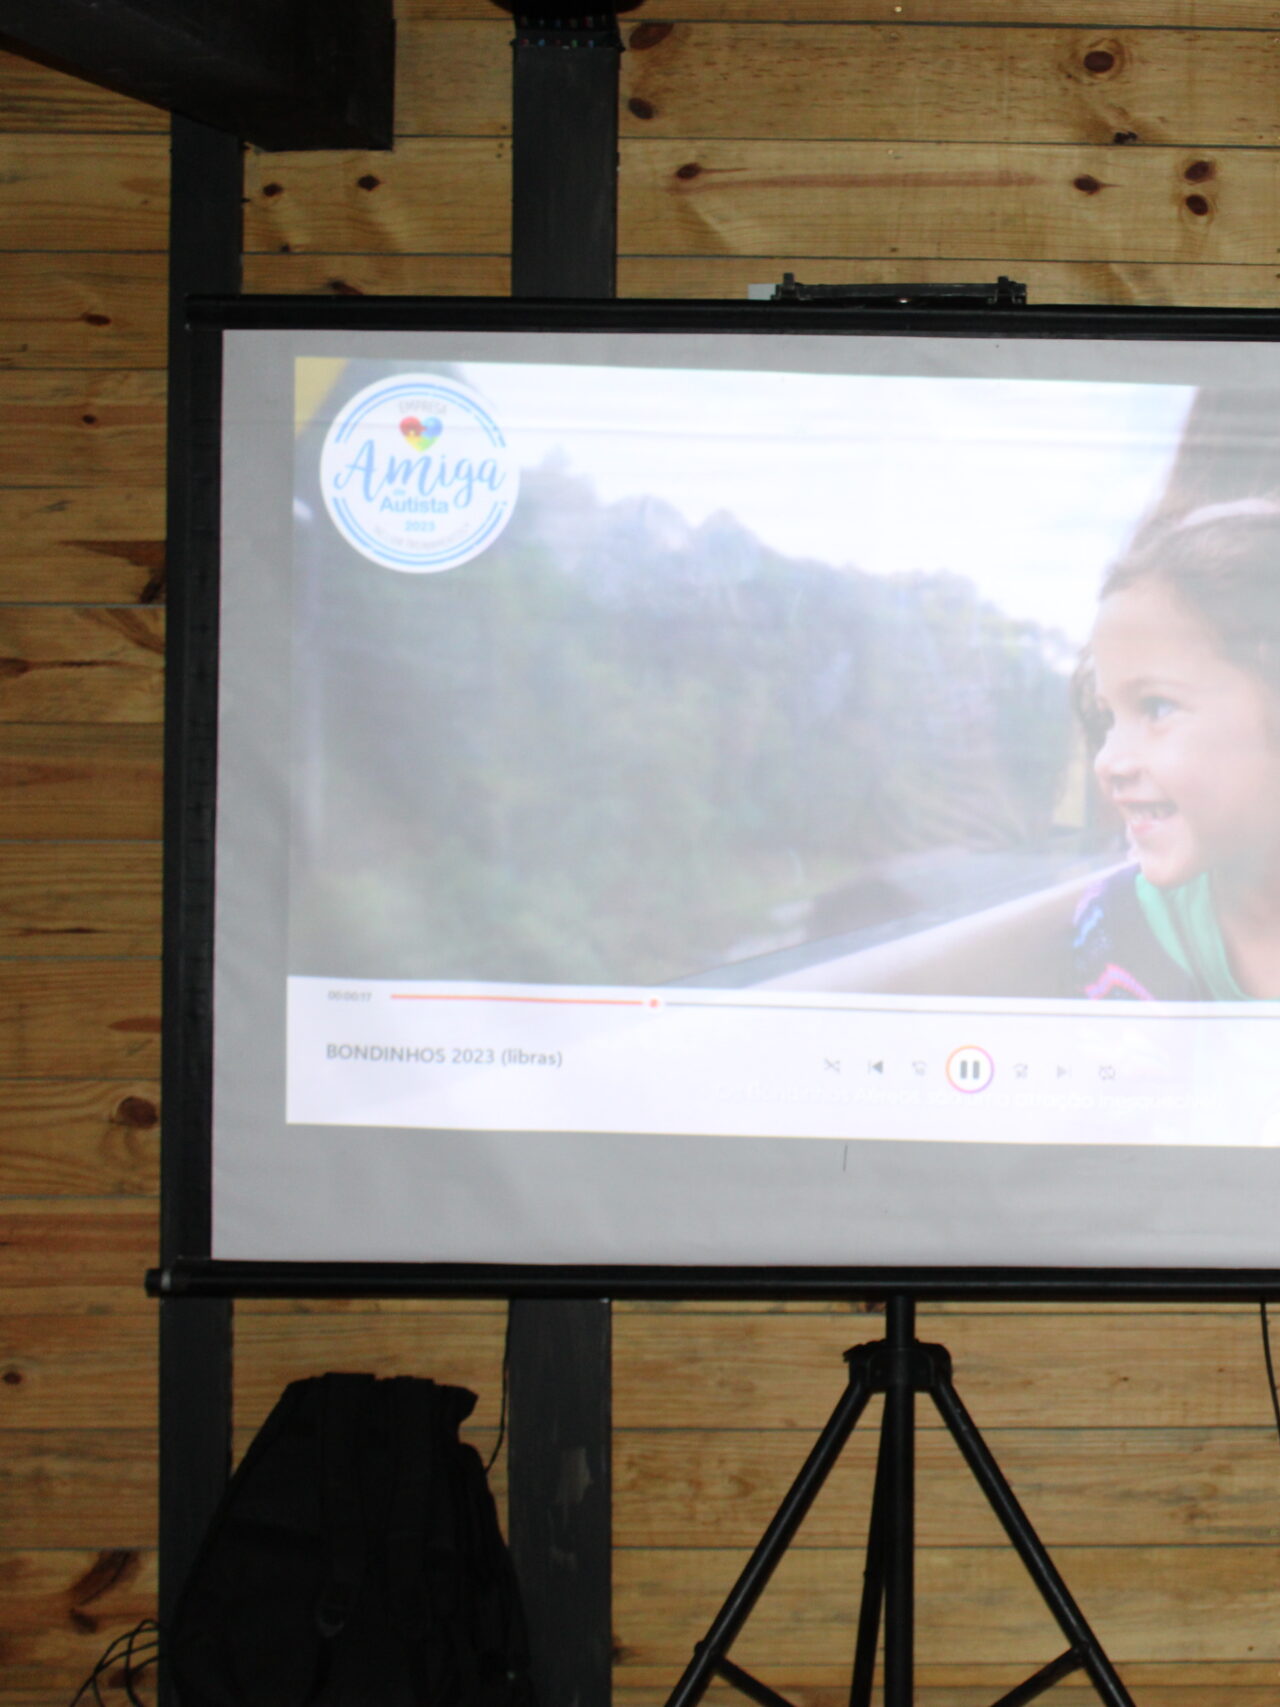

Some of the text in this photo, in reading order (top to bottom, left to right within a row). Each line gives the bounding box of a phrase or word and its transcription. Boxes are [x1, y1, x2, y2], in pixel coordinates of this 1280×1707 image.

[333, 438, 507, 509] Amiga
[380, 496, 450, 514] Autista
[326, 1043, 563, 1067] BONDINHOS 2023 (libras)
